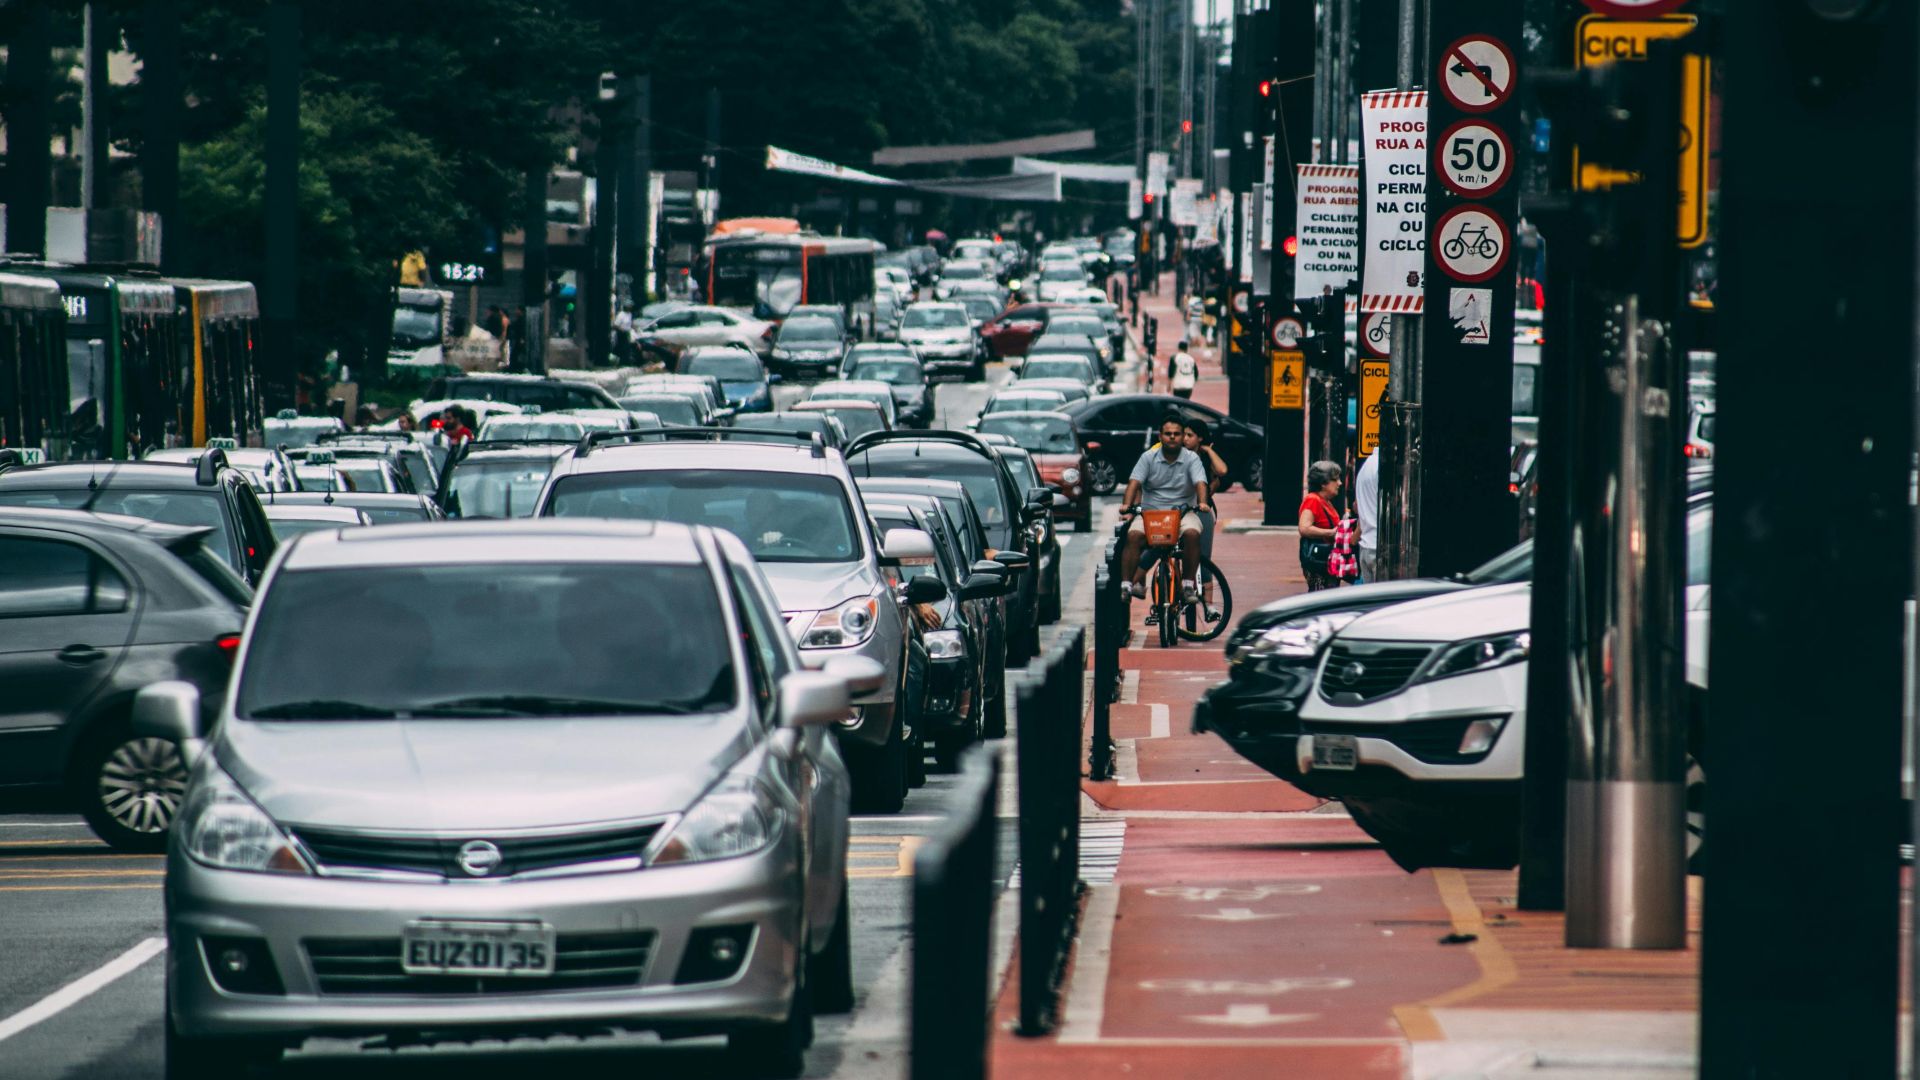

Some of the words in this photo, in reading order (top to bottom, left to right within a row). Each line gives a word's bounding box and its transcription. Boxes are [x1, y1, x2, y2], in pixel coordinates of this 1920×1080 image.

[1375, 139, 1409, 149] RUA
[1451, 138, 1500, 172] 50
[1458, 174, 1488, 184] km/h
[1304, 196, 1326, 204] RUA
[1376, 202, 1399, 213] NA
[1400, 221, 1422, 232] OU
[1318, 251, 1334, 259] OU
